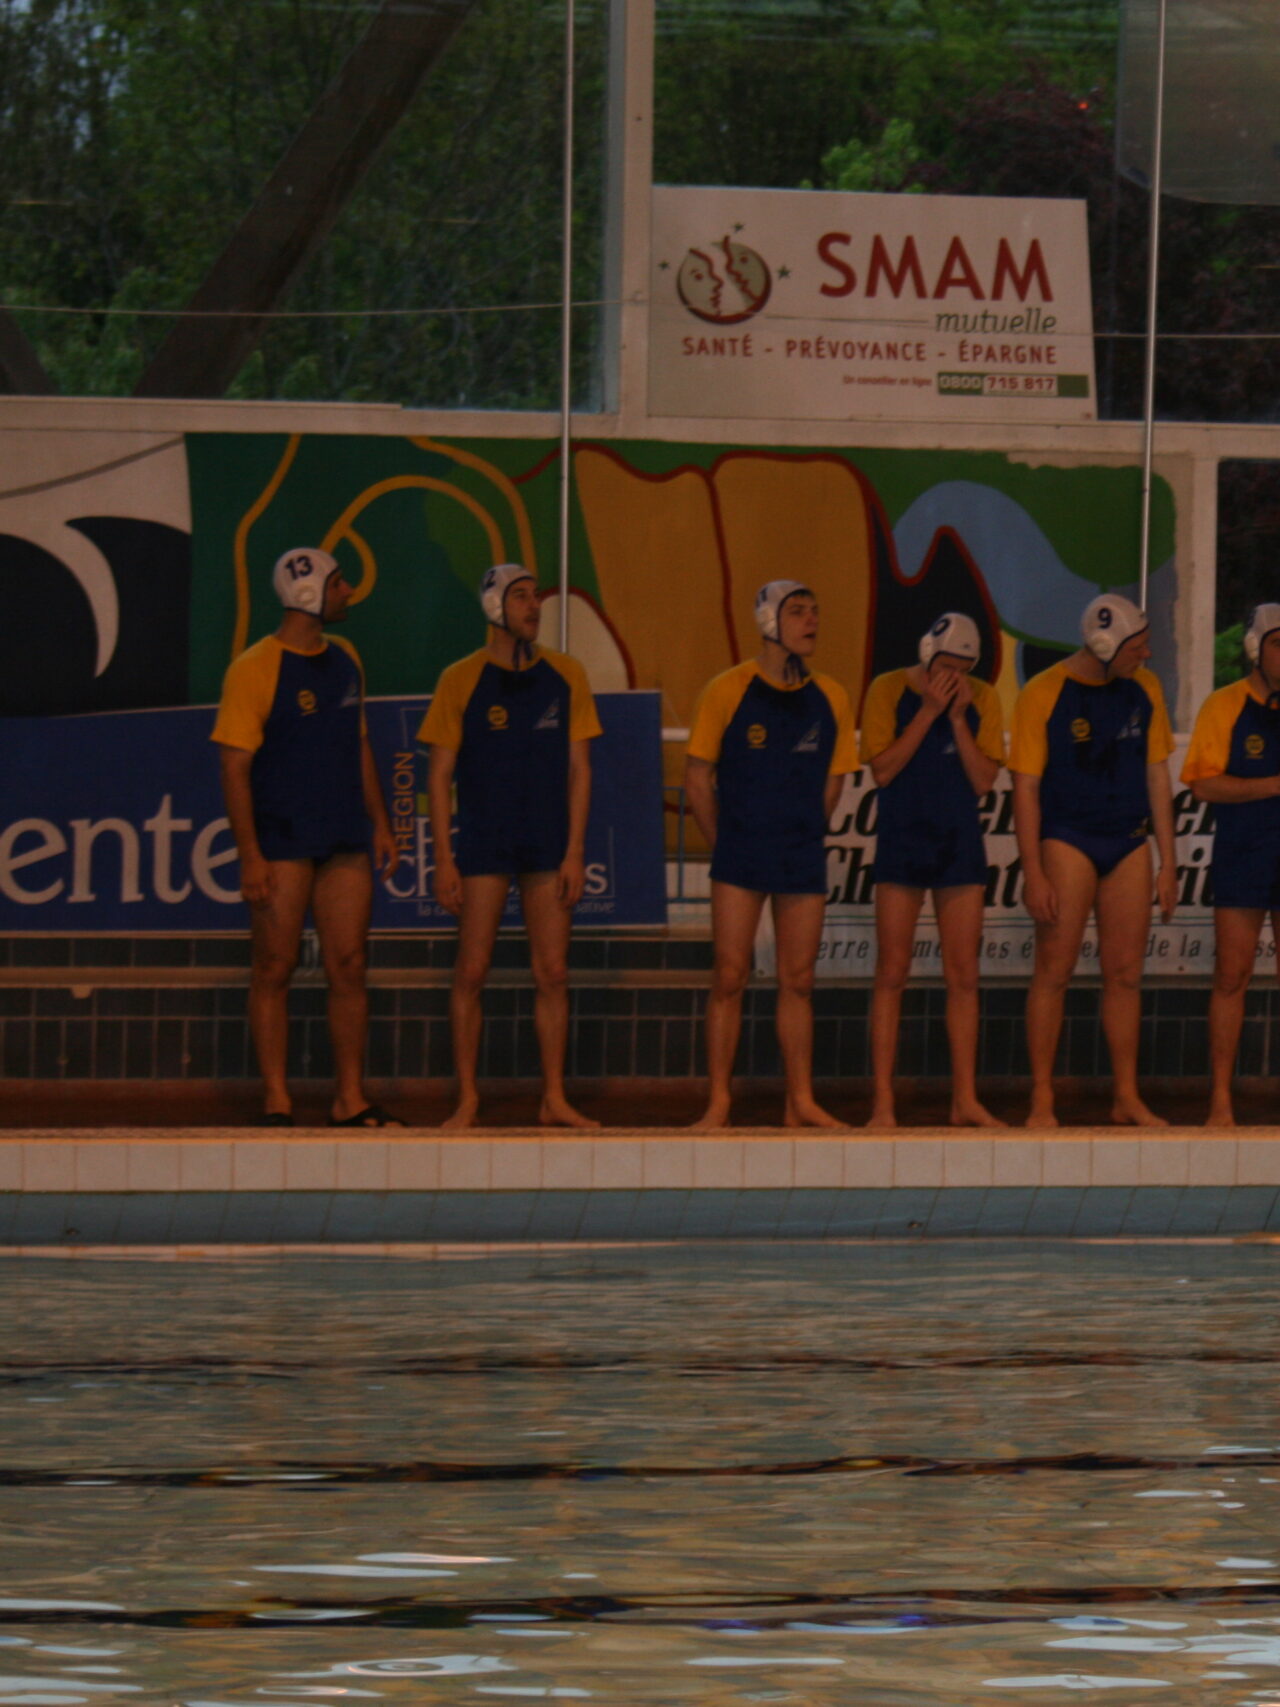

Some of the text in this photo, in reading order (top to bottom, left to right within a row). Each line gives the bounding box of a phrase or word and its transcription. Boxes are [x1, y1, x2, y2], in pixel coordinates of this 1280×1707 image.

[817, 231, 1053, 301] SMAM
[935, 307, 1057, 335] mutuelle
[682, 335, 753, 357] SANTÉ
[786, 336, 926, 362] PRÉVOYANCE
[958, 339, 1057, 365] ÉPARGNE
[939, 375, 1056, 390] 0800 715 817
[285, 556, 313, 580] 13
[1098, 608, 1112, 629] 9
